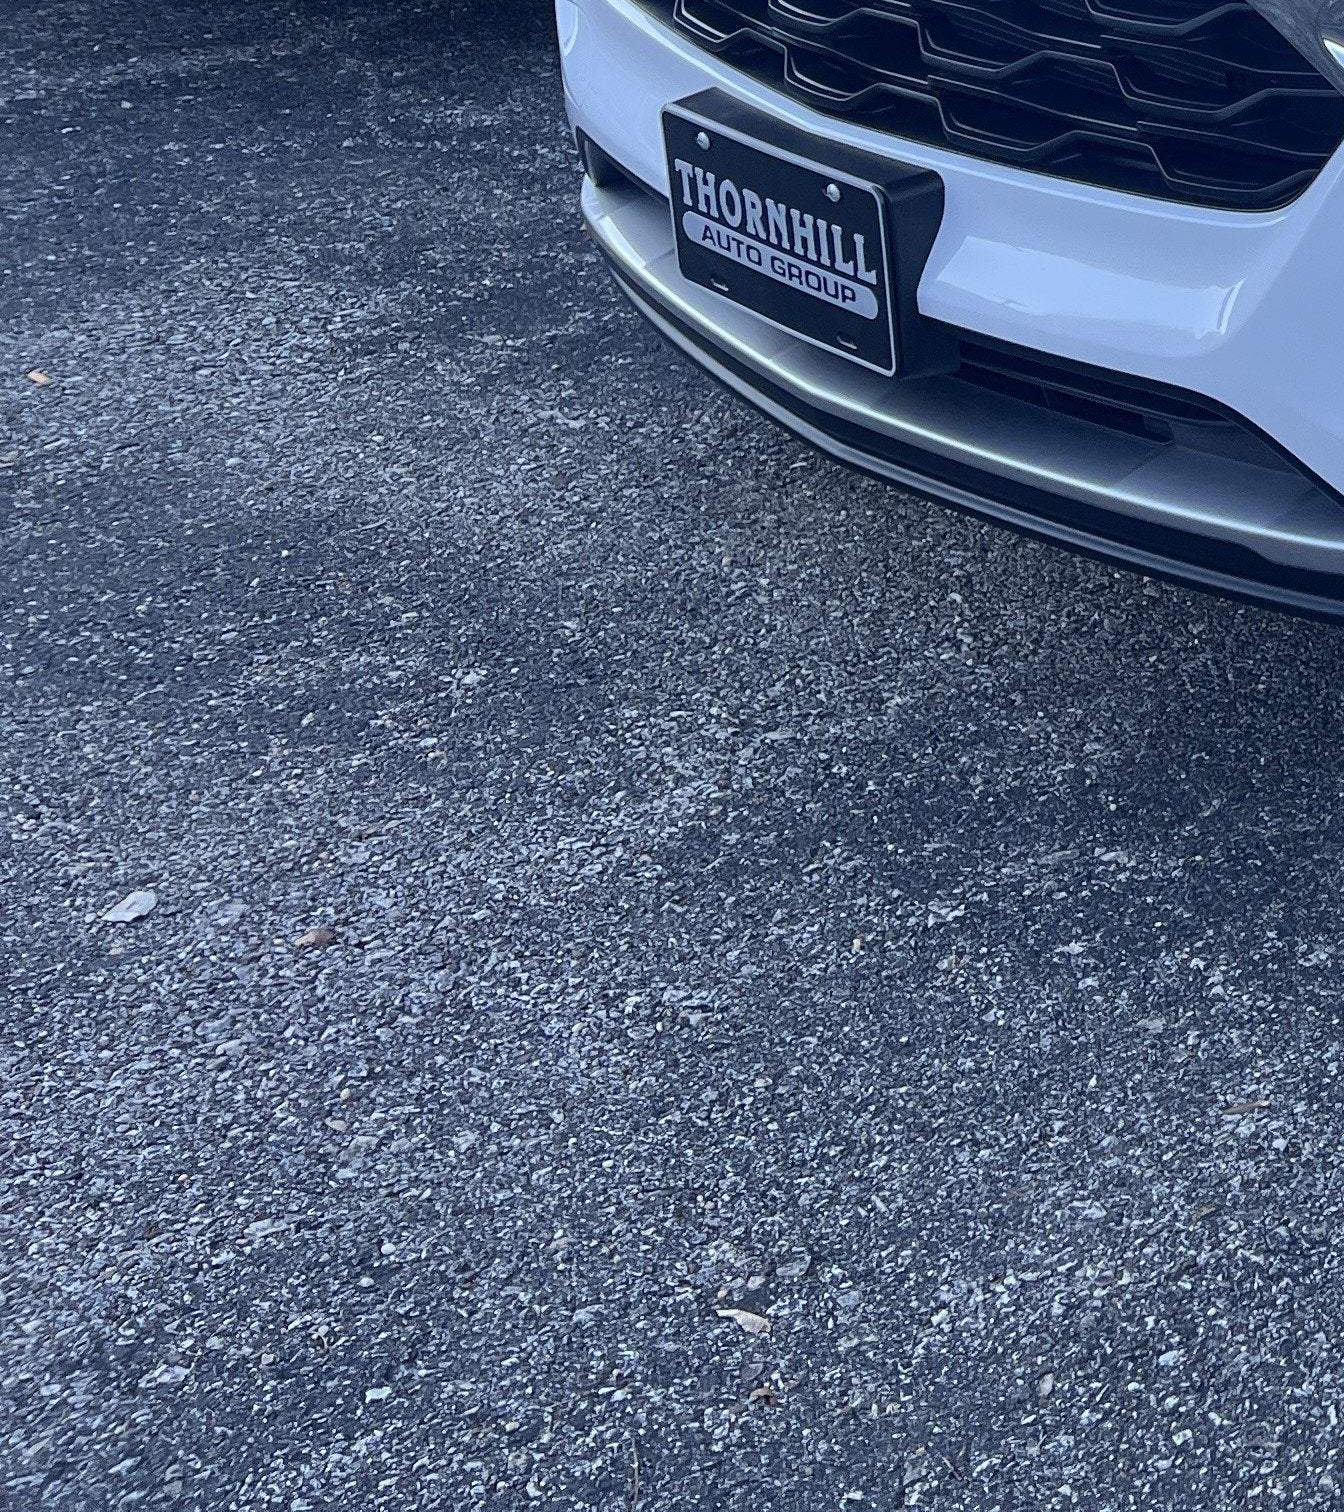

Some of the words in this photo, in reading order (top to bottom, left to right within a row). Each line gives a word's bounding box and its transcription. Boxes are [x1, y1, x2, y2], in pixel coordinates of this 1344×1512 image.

[674, 158, 877, 285] THORNHILL
[701, 224, 762, 267] AUTO
[770, 255, 857, 304] GROUP
